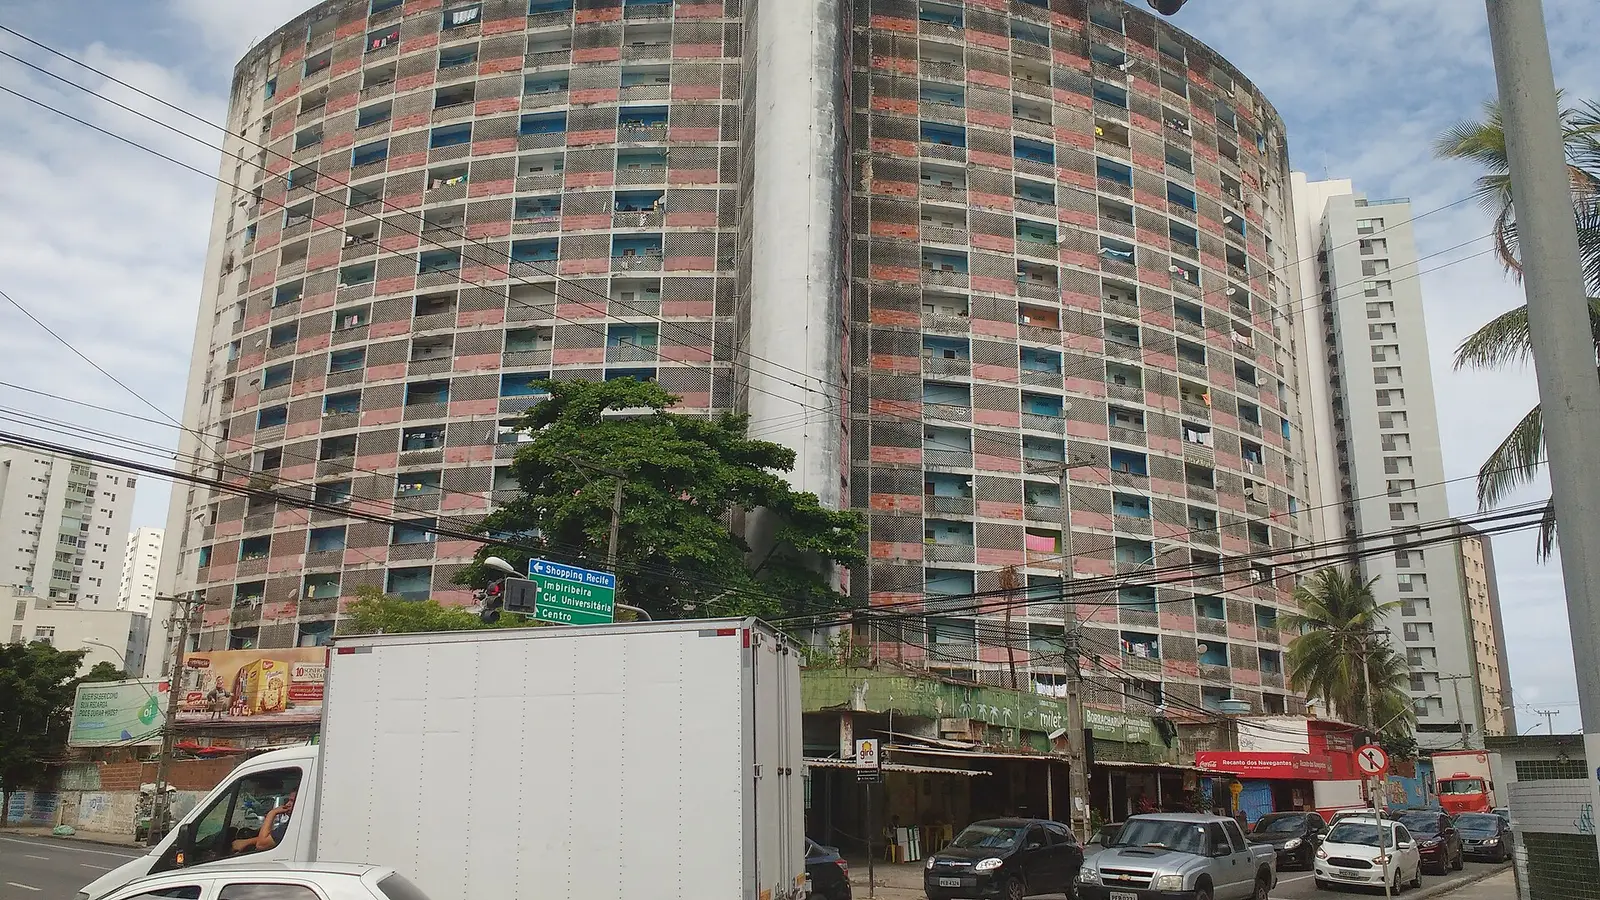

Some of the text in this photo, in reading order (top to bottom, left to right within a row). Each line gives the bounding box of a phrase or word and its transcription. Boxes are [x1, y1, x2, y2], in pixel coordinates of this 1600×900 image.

[545, 565, 609, 585] Shopping Recife
[543, 580, 592, 597] Imbiribeira
[543, 592, 612, 612] Cid. Universitária
[542, 609, 572, 621] Centro
[296, 667, 304, 677] 10
[1258, 759, 1292, 767] Navegantes
